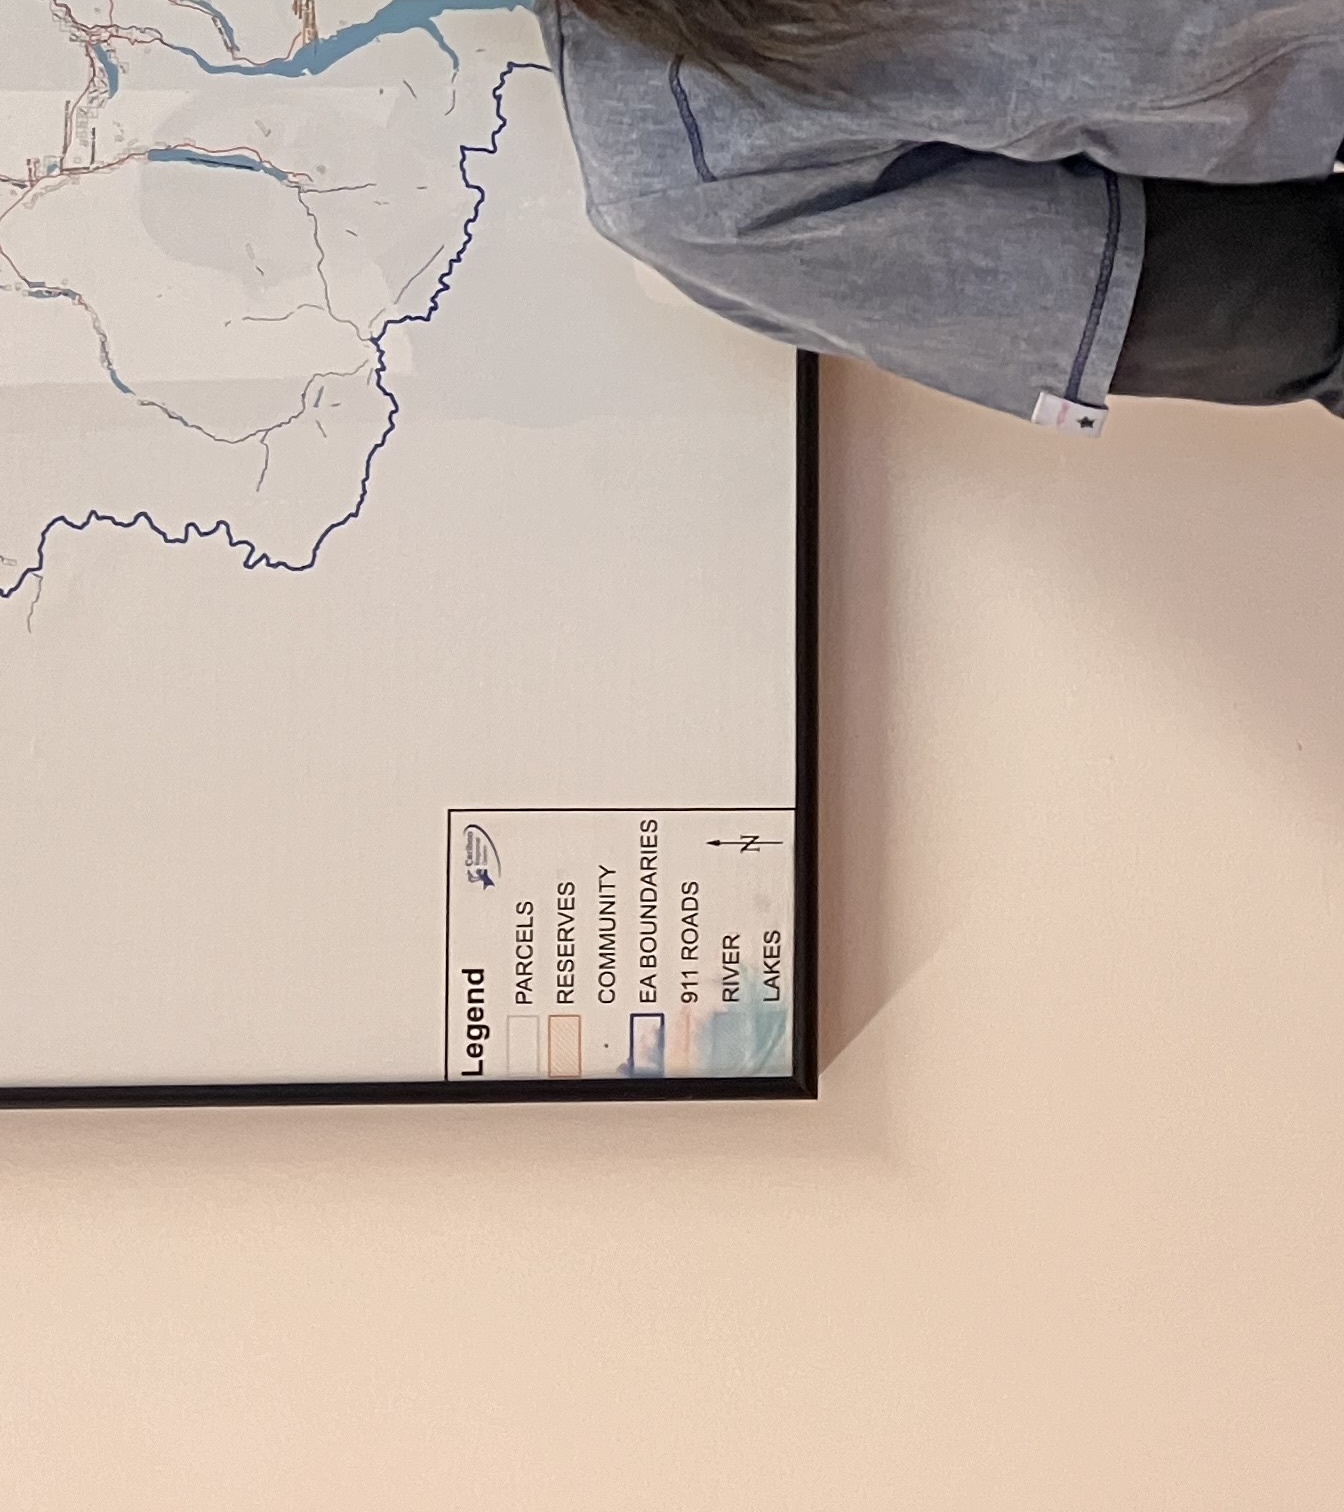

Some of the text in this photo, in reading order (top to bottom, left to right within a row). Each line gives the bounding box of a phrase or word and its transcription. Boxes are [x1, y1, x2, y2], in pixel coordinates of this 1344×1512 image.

[740, 834, 760, 854] N
[515, 901, 534, 1005] PARCELS
[556, 882, 576, 1004] RESERVES
[597, 865, 616, 1004] COMMUNITY
[639, 819, 658, 1003] EA BOUNDARIES
[680, 881, 698, 1004] 911 ROADS
[722, 934, 740, 1002] RIVER
[762, 930, 780, 1002] LAKES
[461, 968, 490, 1076] Legend
